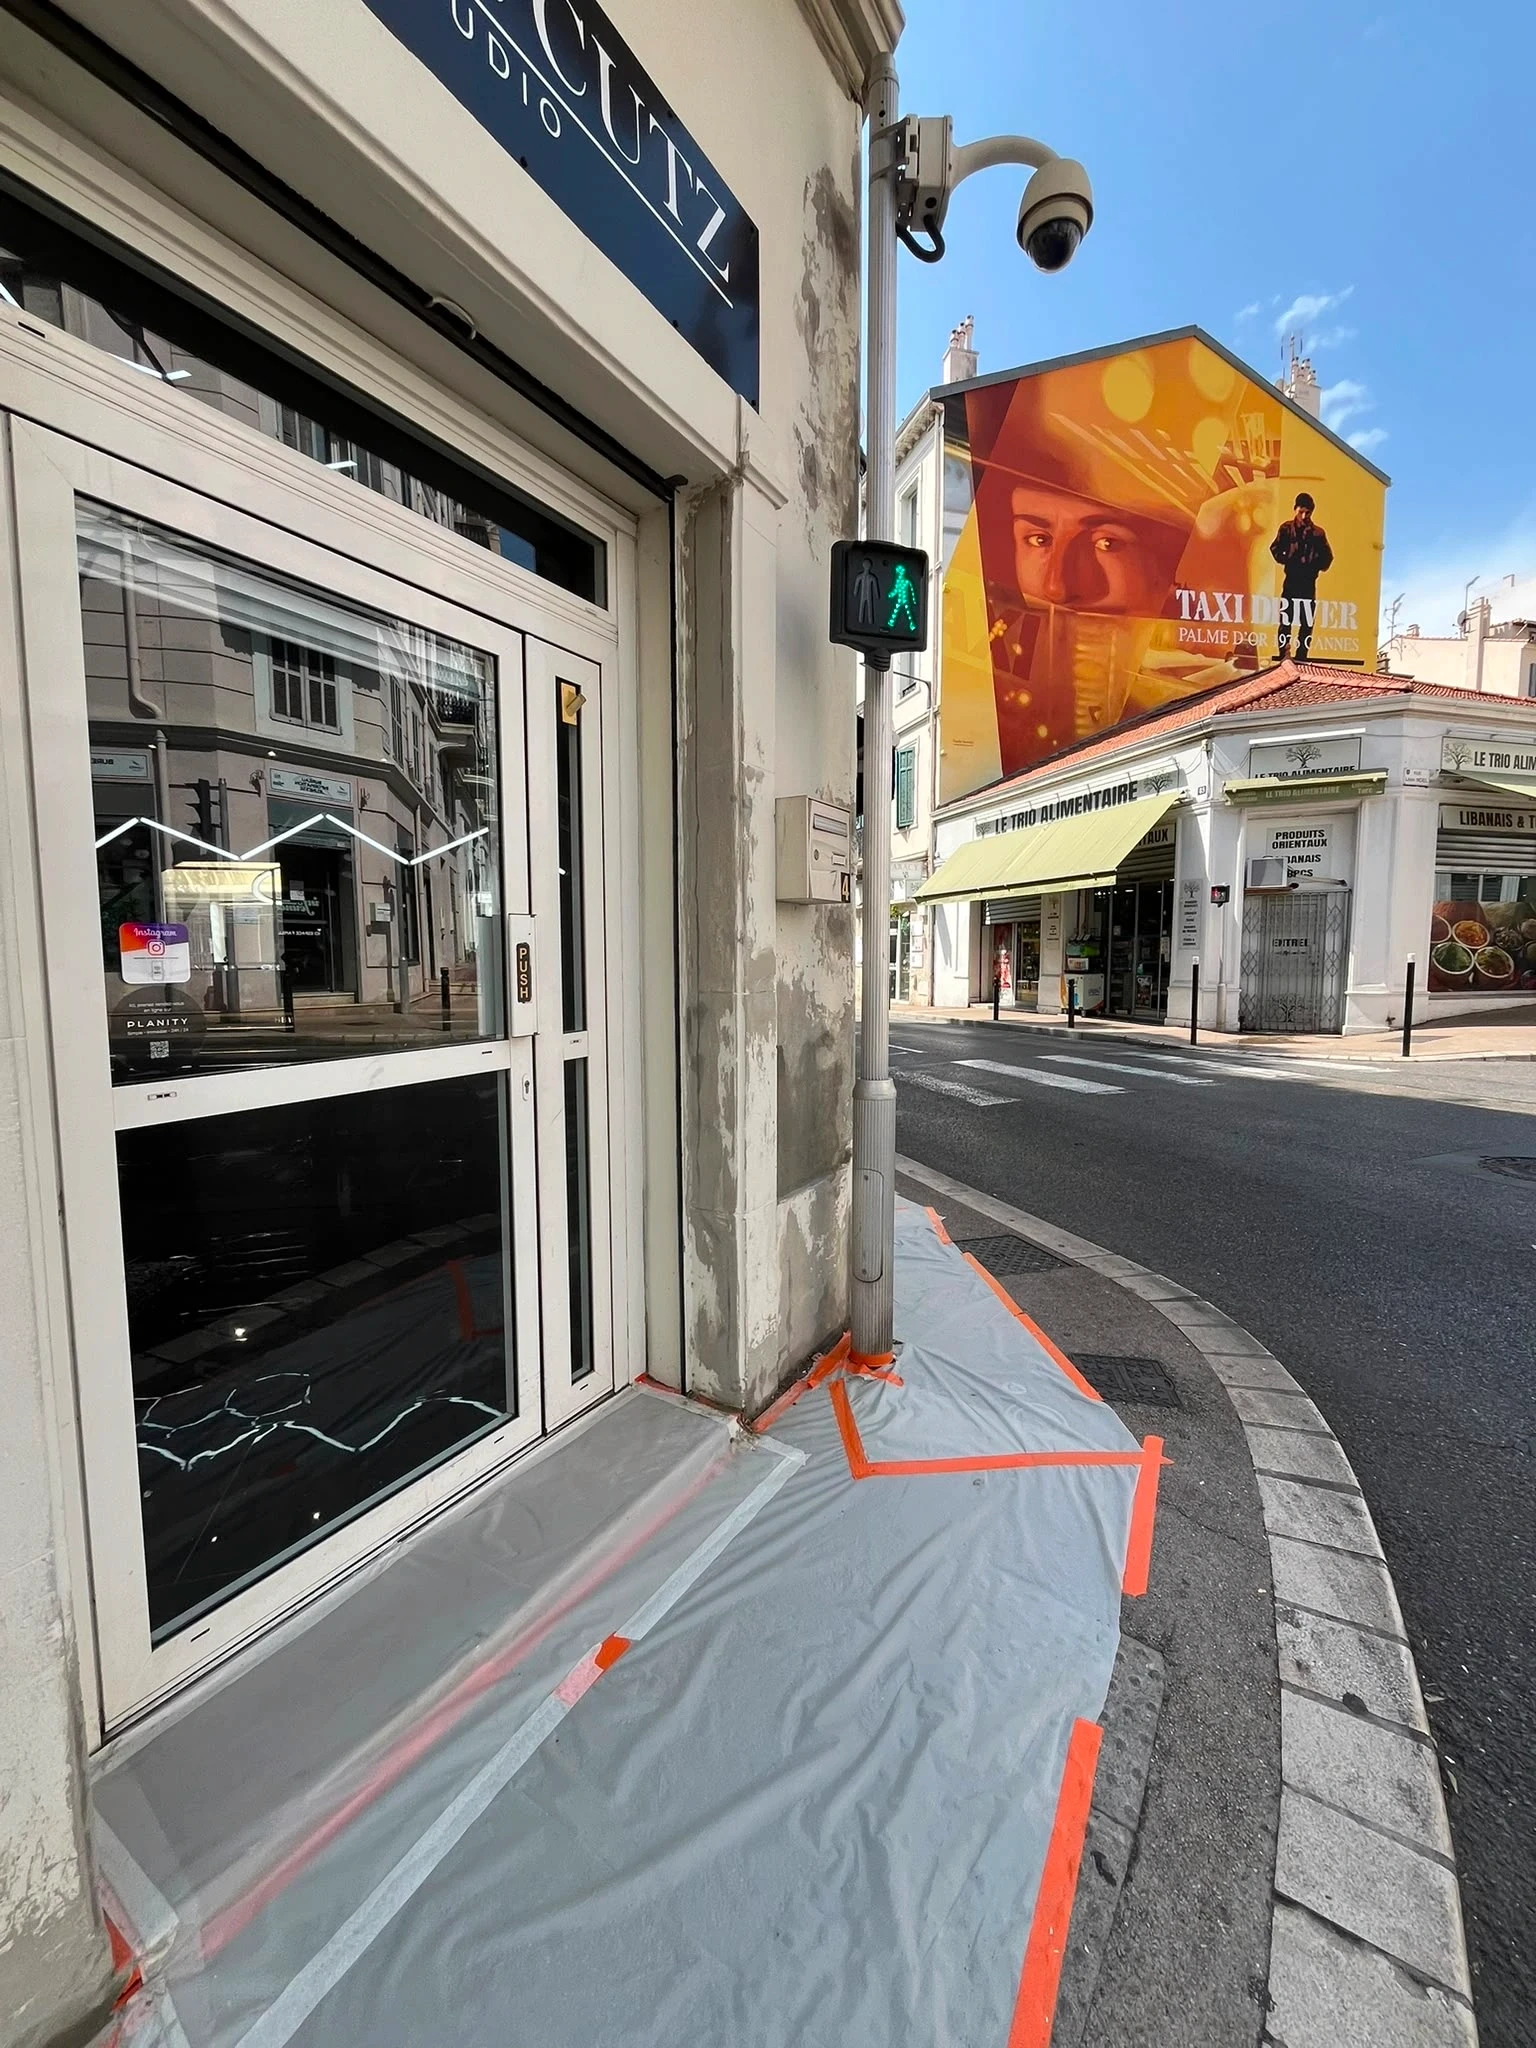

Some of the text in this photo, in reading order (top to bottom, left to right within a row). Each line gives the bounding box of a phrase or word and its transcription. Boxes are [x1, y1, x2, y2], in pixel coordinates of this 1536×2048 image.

[1176, 589, 1358, 630] TAXI DRIVER
[1179, 627, 1230, 643] PALME
[1233, 631, 1268, 647] D'OR
[1304, 636, 1360, 652] CANNES
[1474, 751, 1486, 767] LE
[1489, 753, 1511, 769] TRIO
[1275, 789, 1291, 798] TRIO
[995, 780, 1139, 835] LE TRIO ALIMENTAIRE
[1459, 810, 1513, 828] LIBANAIS
[1516, 815, 1525, 828] &
[1275, 829, 1325, 840] PRODUITS
[1271, 838, 1328, 850] ORIENTAUX
[842, 875, 849, 901] 4
[133, 928, 178, 939] Instagram
[519, 947, 529, 999] PUSH
[127, 1017, 188, 1029] PLANITY
